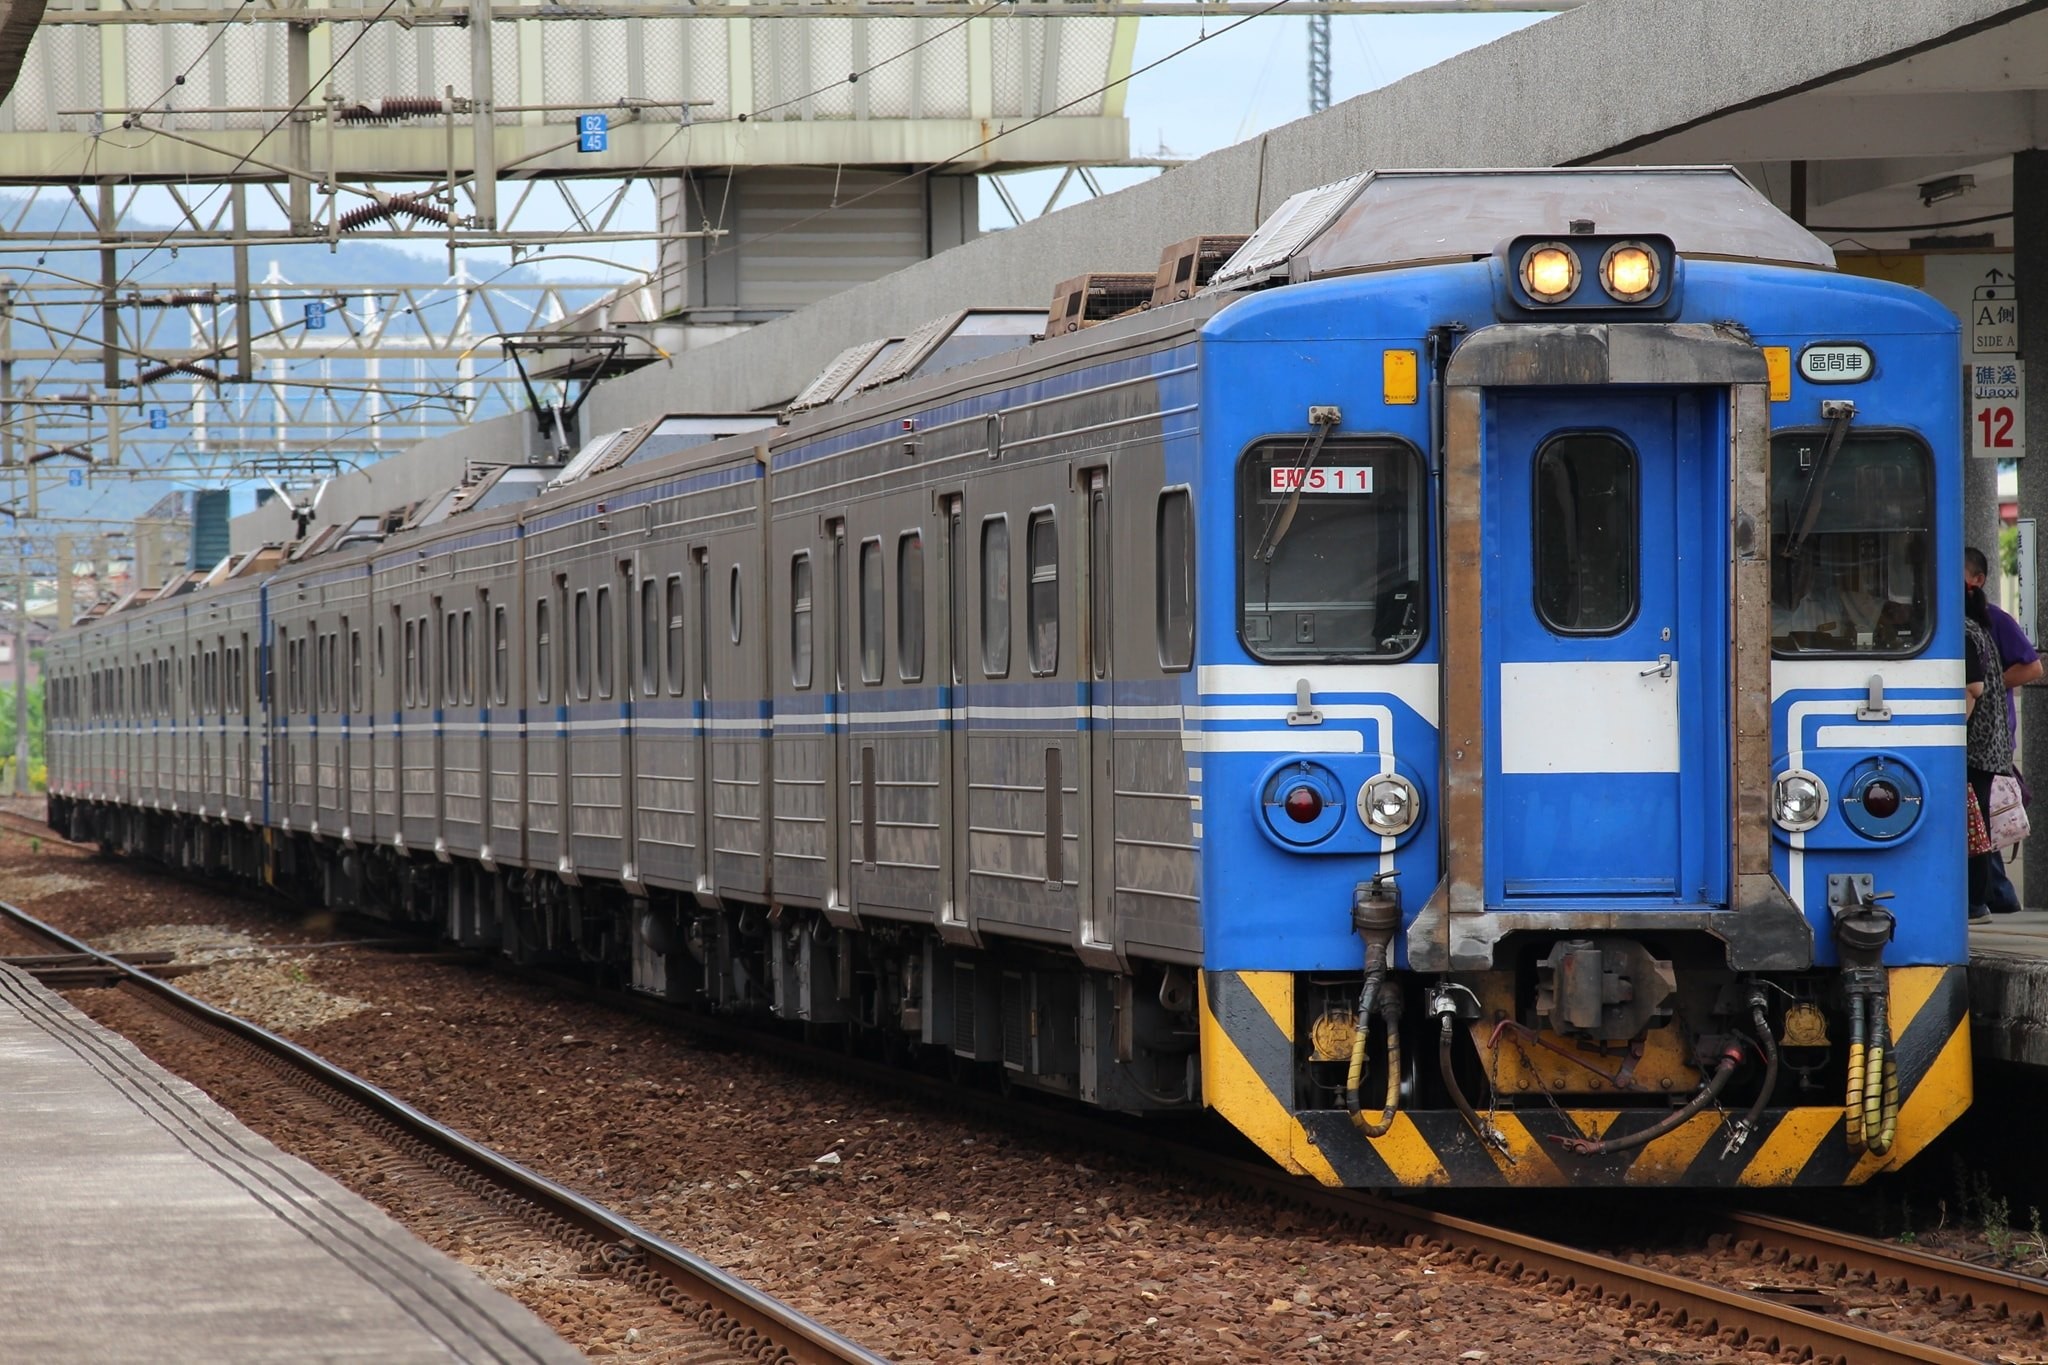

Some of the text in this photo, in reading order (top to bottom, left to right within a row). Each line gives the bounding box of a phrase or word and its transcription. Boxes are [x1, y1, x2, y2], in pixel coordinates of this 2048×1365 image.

[586, 116, 602, 131] 62
[587, 135, 602, 150] 45
[1976, 335, 2015, 347] SIDE A
[1809, 353, 1863, 372] 區間車
[1976, 365, 2017, 385] 礁溪
[1978, 406, 2014, 448] 12
